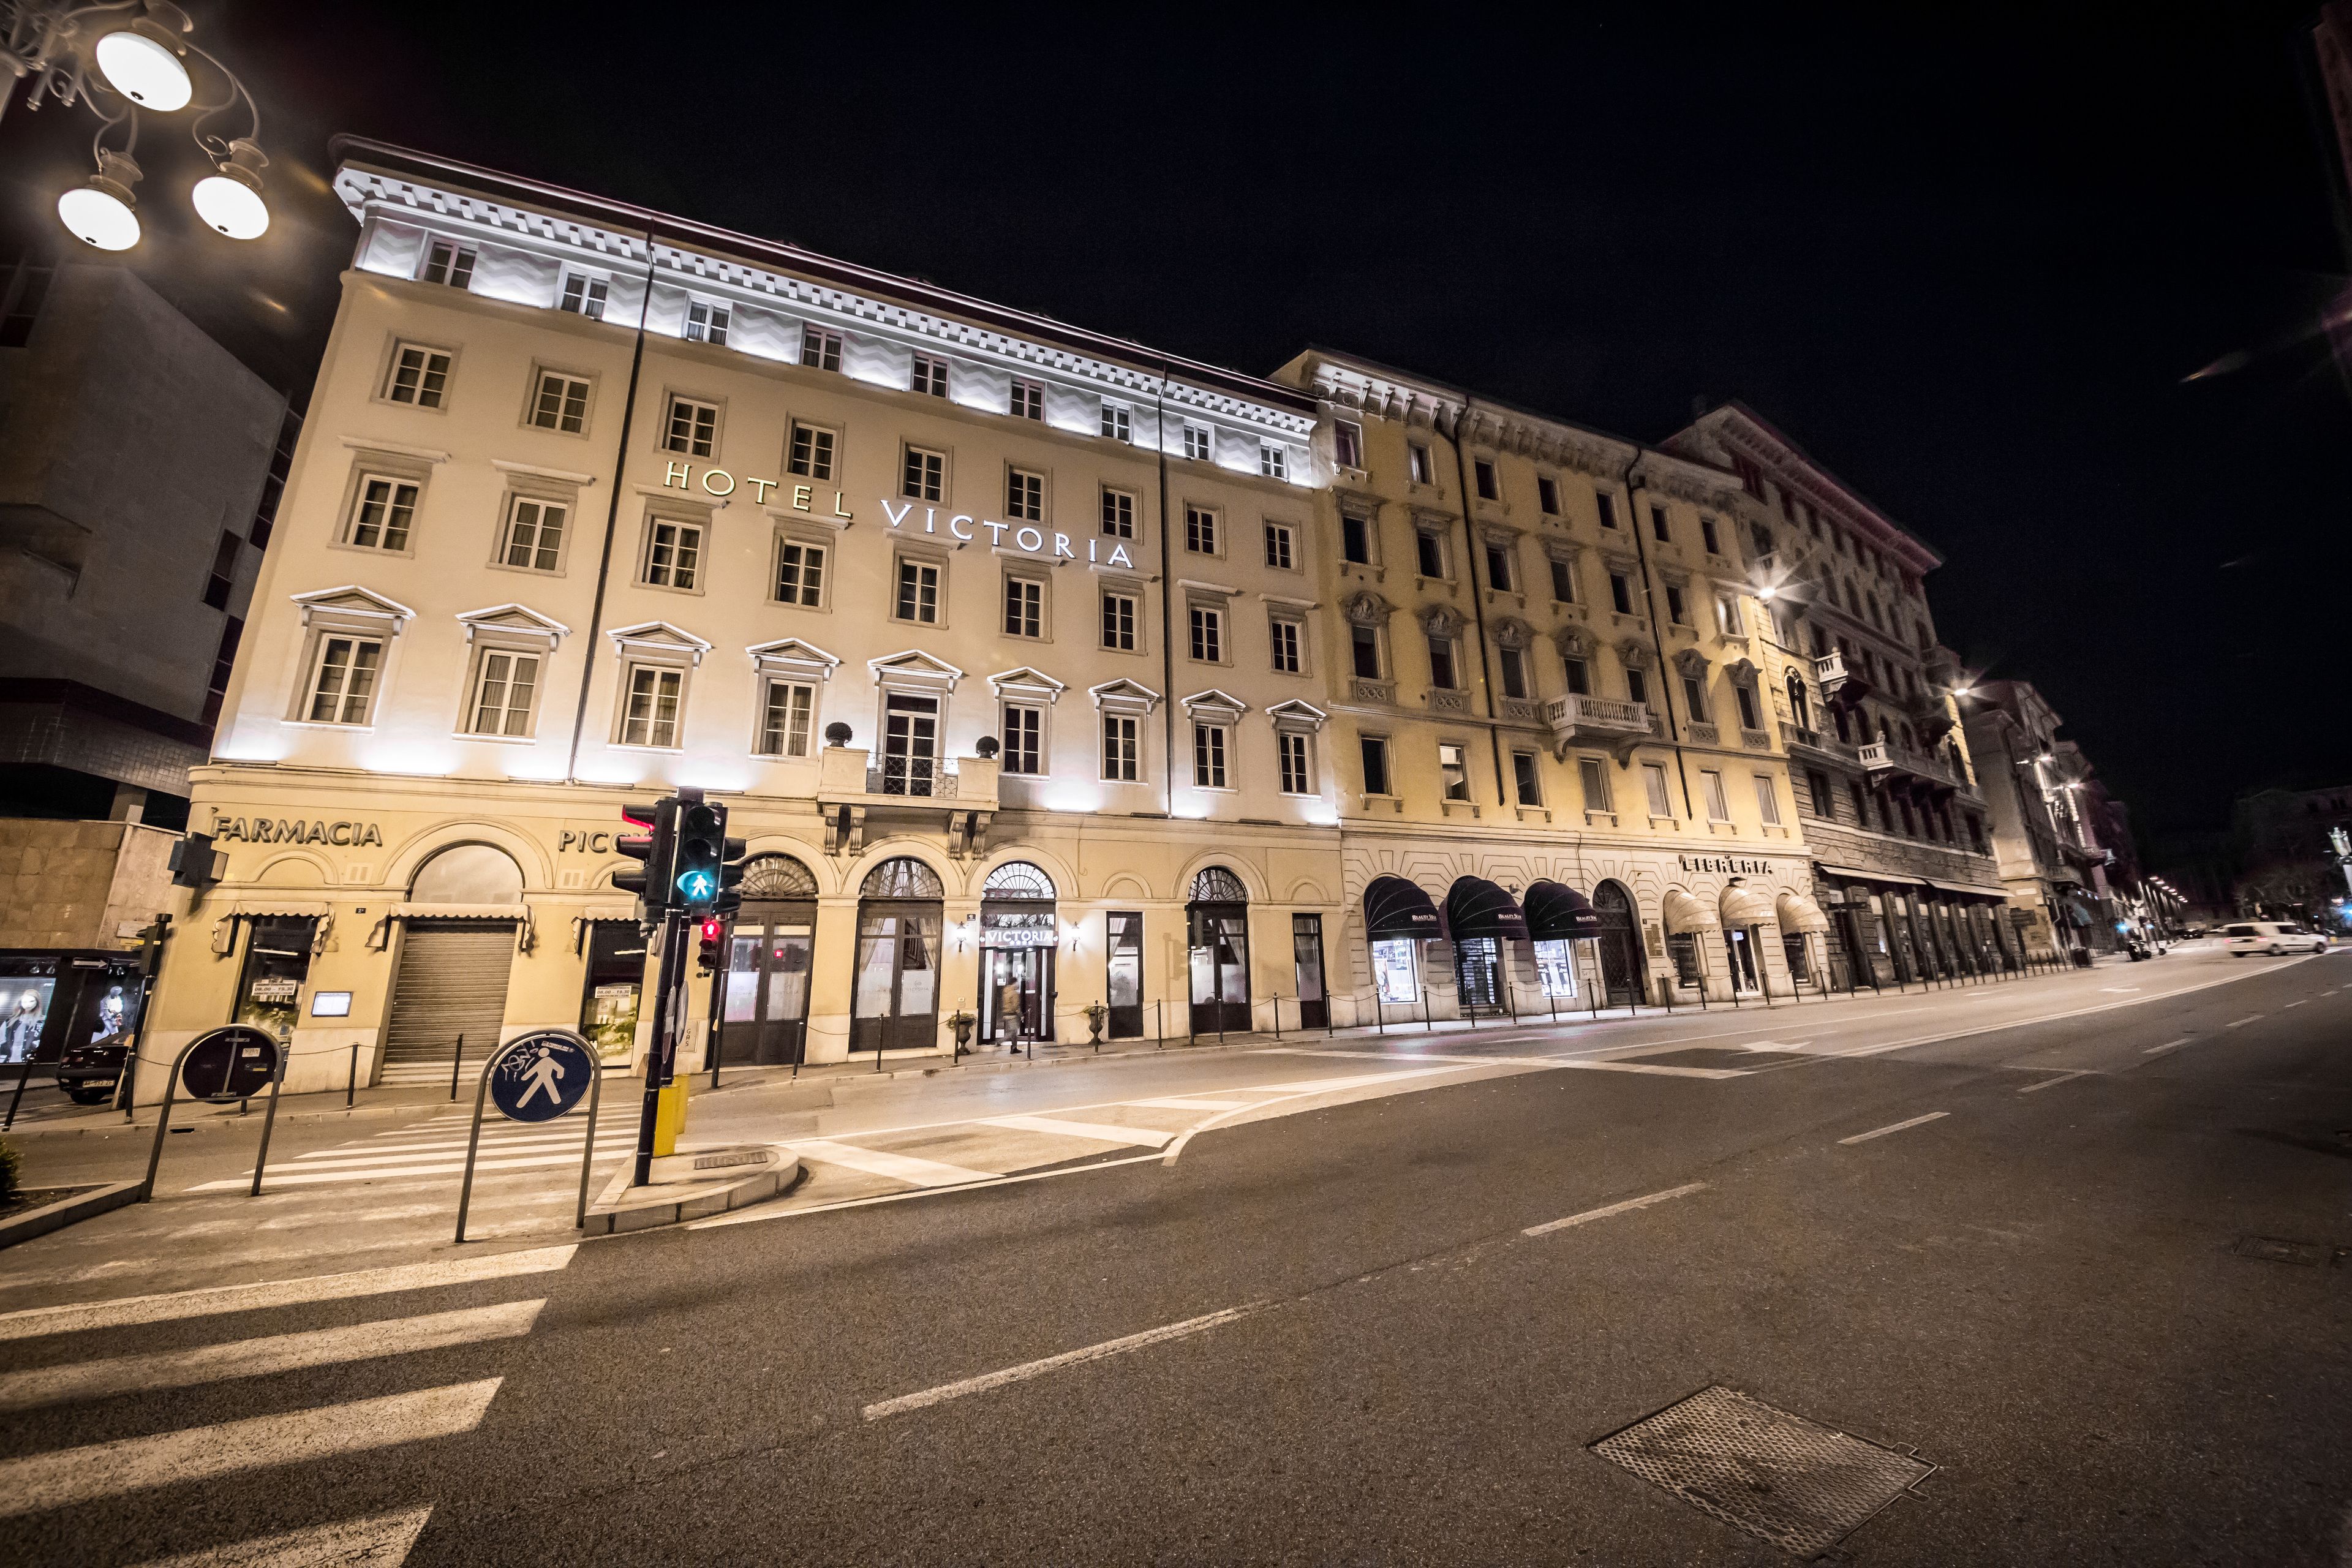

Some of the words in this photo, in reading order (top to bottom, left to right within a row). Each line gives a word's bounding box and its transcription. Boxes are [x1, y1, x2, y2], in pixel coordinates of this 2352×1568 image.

[663, 461, 853, 518] HOTEL
[880, 499, 1133, 569] VICTORIA
[211, 816, 383, 847] FARMACIA
[1682, 856, 1773, 875] LIBRERIA
[988, 930, 1052, 942] VICTORIA
